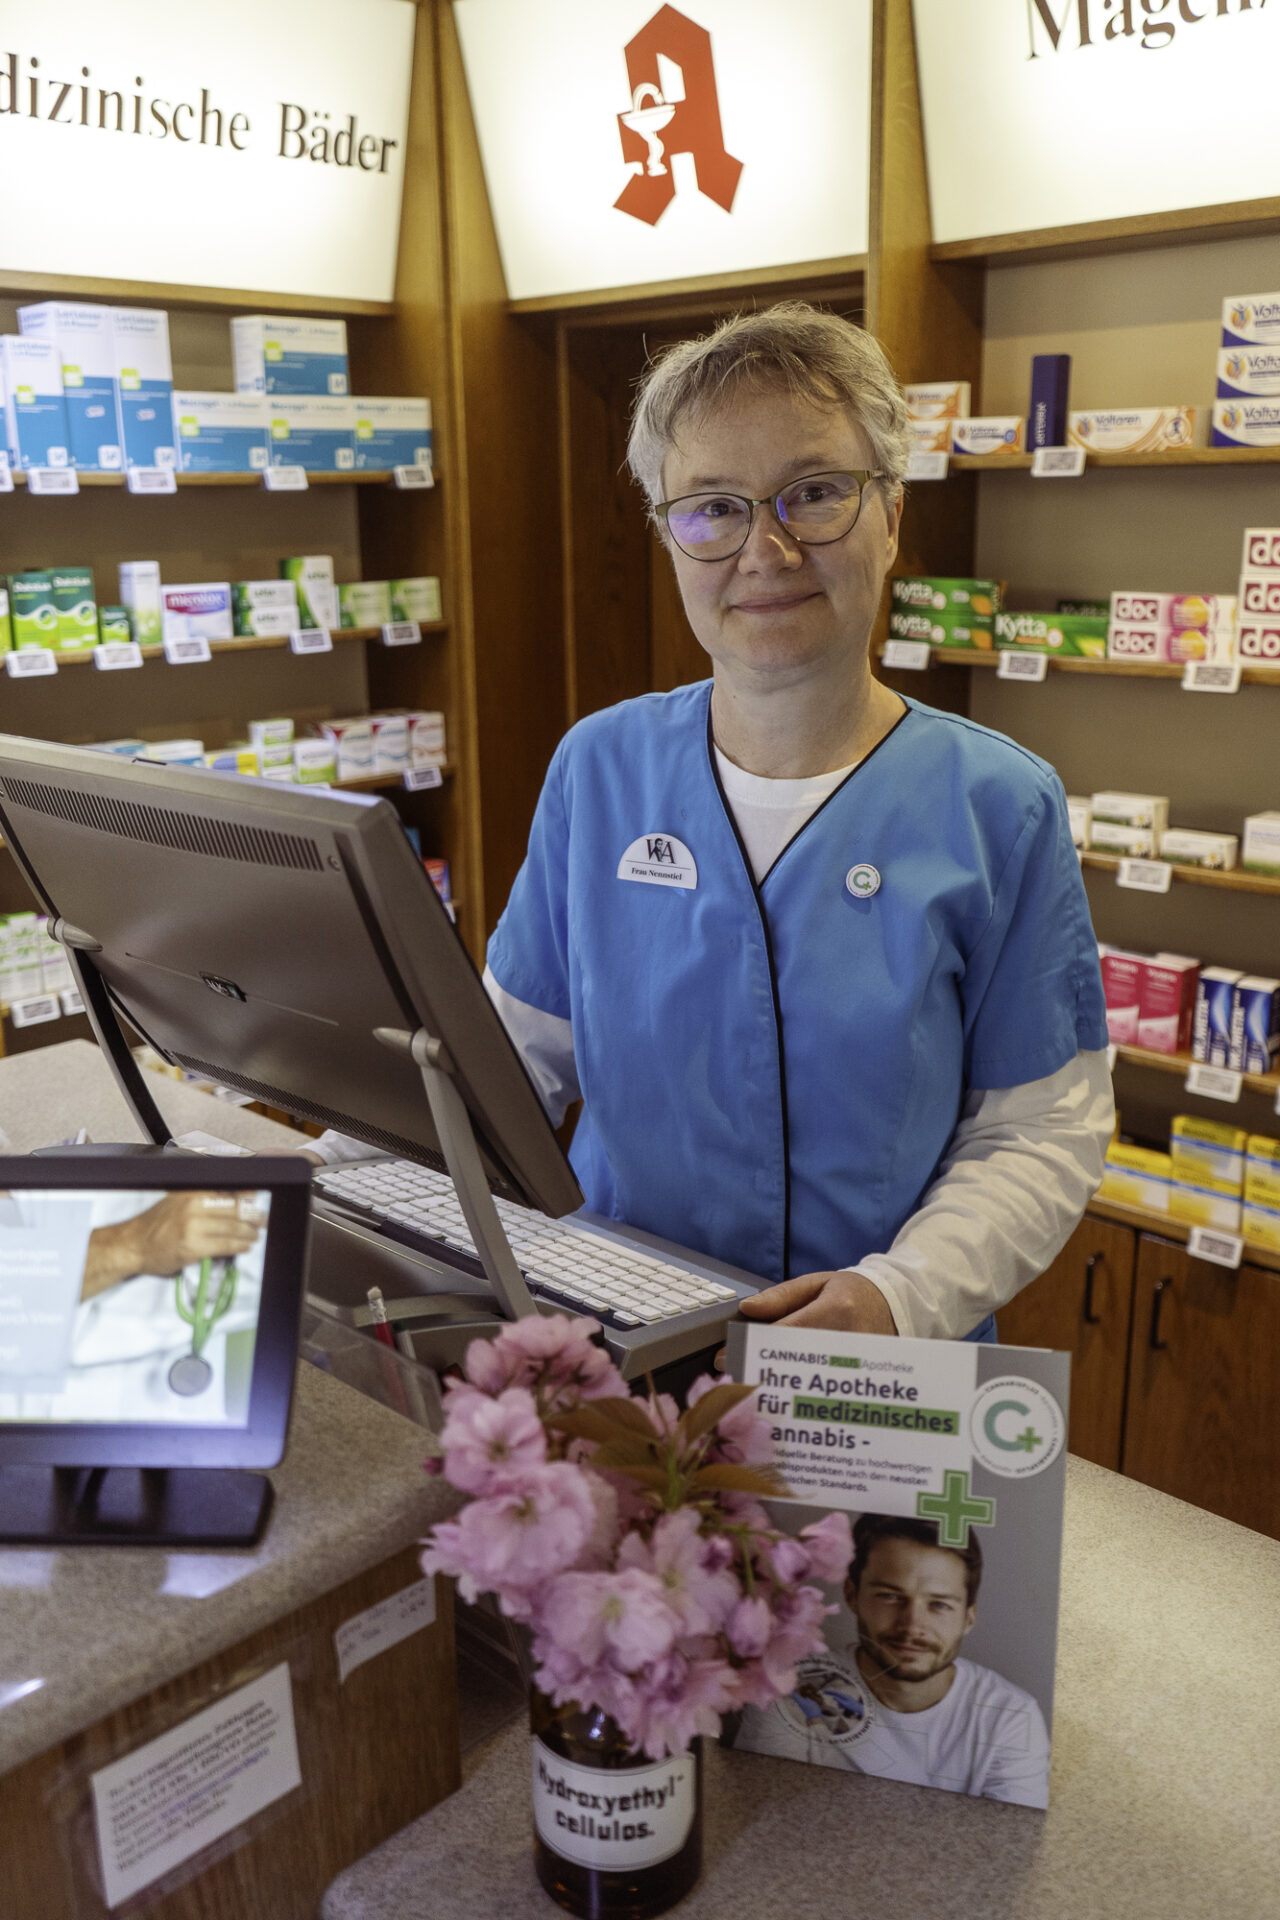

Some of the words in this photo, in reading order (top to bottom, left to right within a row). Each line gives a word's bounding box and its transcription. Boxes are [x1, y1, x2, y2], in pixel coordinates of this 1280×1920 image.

[277, 103, 398, 172] Bäder
[893, 581, 933, 603] Kytta
[1117, 598, 1158, 621] doc
[891, 613, 931, 636] Kytta
[995, 614, 1047, 641] Kytta
[1113, 631, 1155, 653] doc
[631, 867, 647, 876] Frau
[759, 1348, 828, 1365] CANNABIS
[759, 1367, 802, 1389] Ihre
[808, 1373, 919, 1401] Apotheke
[757, 1393, 791, 1415] für
[796, 1402, 954, 1433] medizinisches
[770, 1426, 856, 1449] annabis
[556, 1810, 655, 1842] cellulos.
